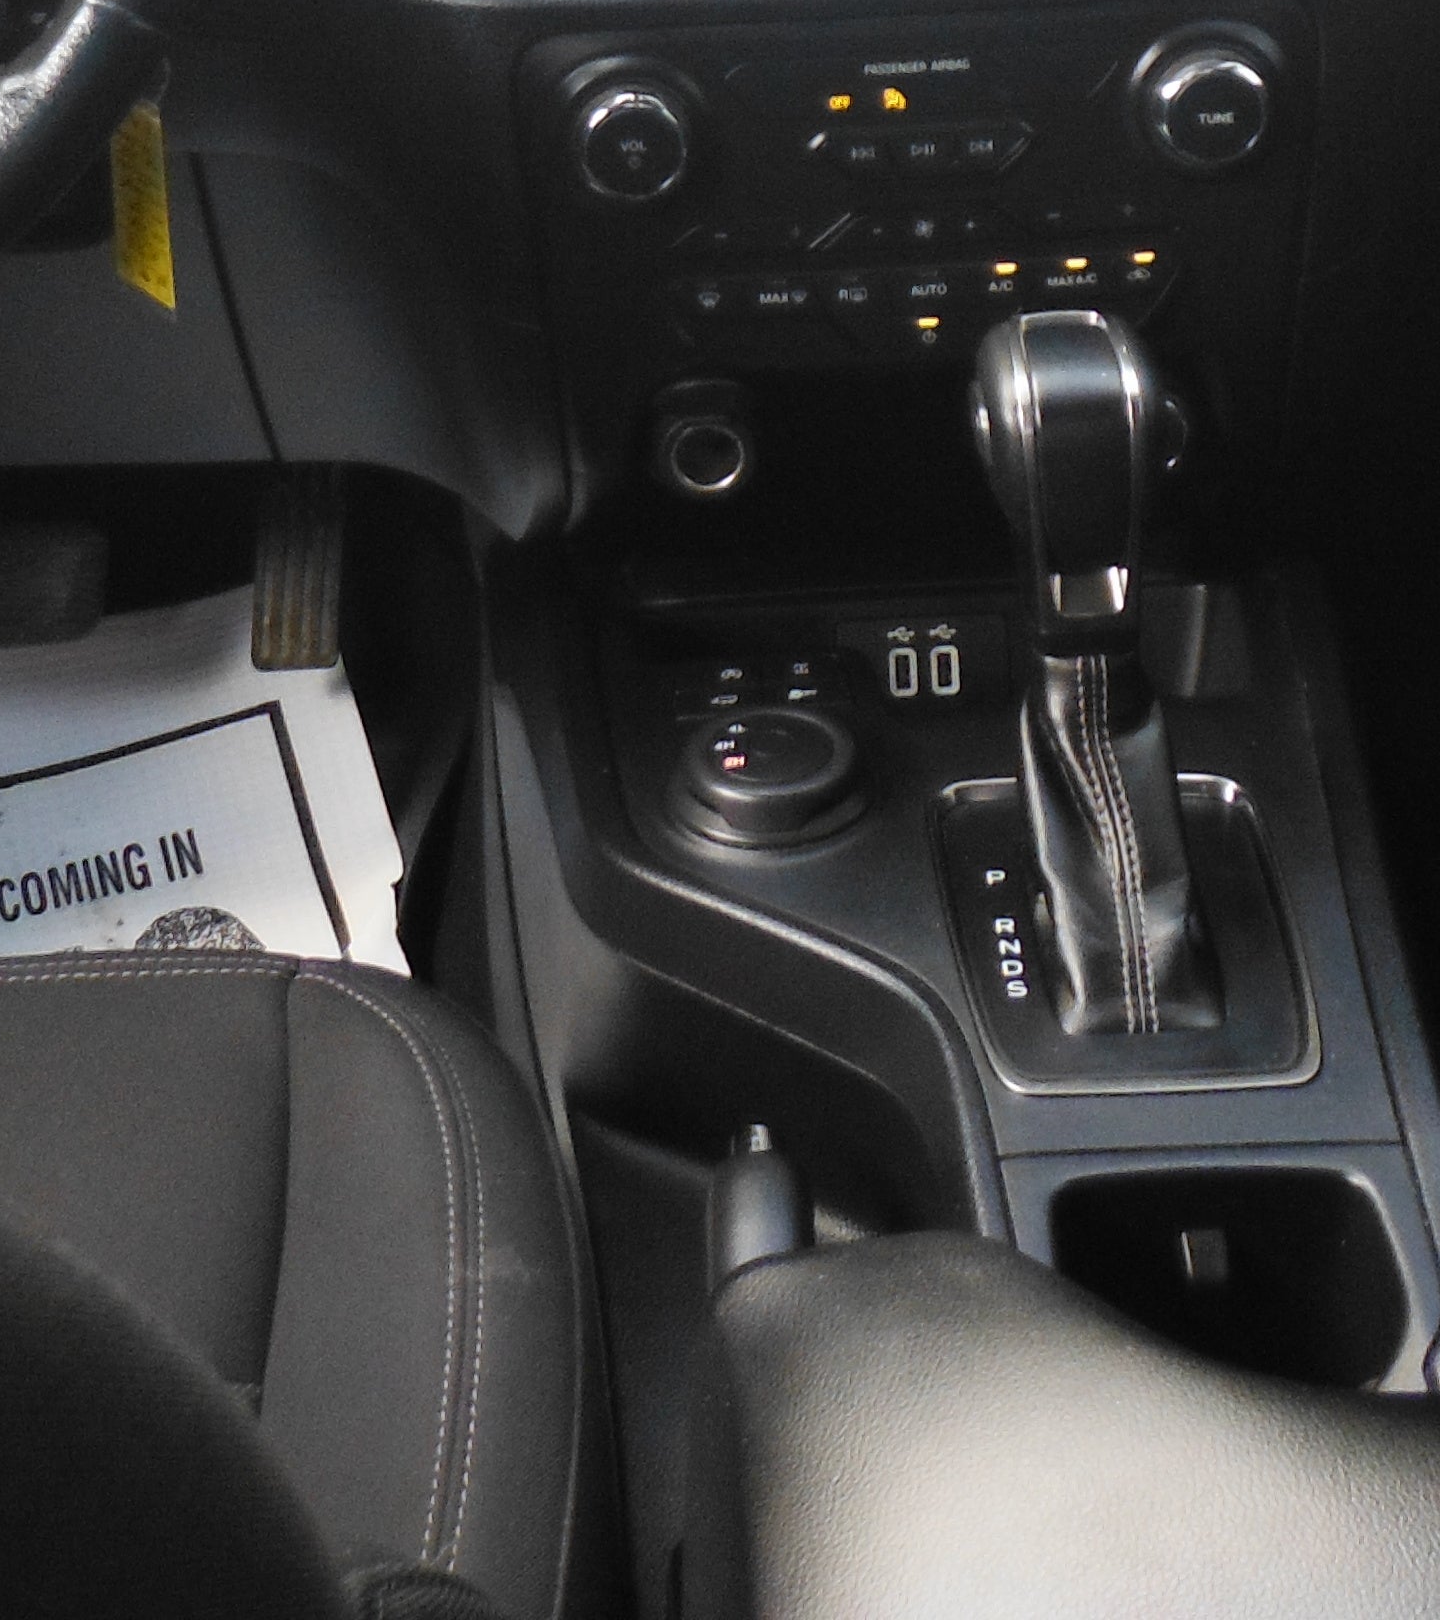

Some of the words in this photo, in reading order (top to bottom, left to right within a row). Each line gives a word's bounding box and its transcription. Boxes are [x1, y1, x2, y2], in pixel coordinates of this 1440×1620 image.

[1198, 111, 1235, 125] TUNE
[619, 139, 648, 152] VOL
[911, 283, 948, 297] AUTO
[988, 280, 1014, 293] A/C
[759, 292, 789, 305] MAX
[160, 829, 204, 880] IN
[986, 869, 1007, 886] P
[994, 917, 1016, 935] R
[998, 938, 1023, 955] N
[1001, 959, 1024, 977] D
[1007, 980, 1029, 998] S
